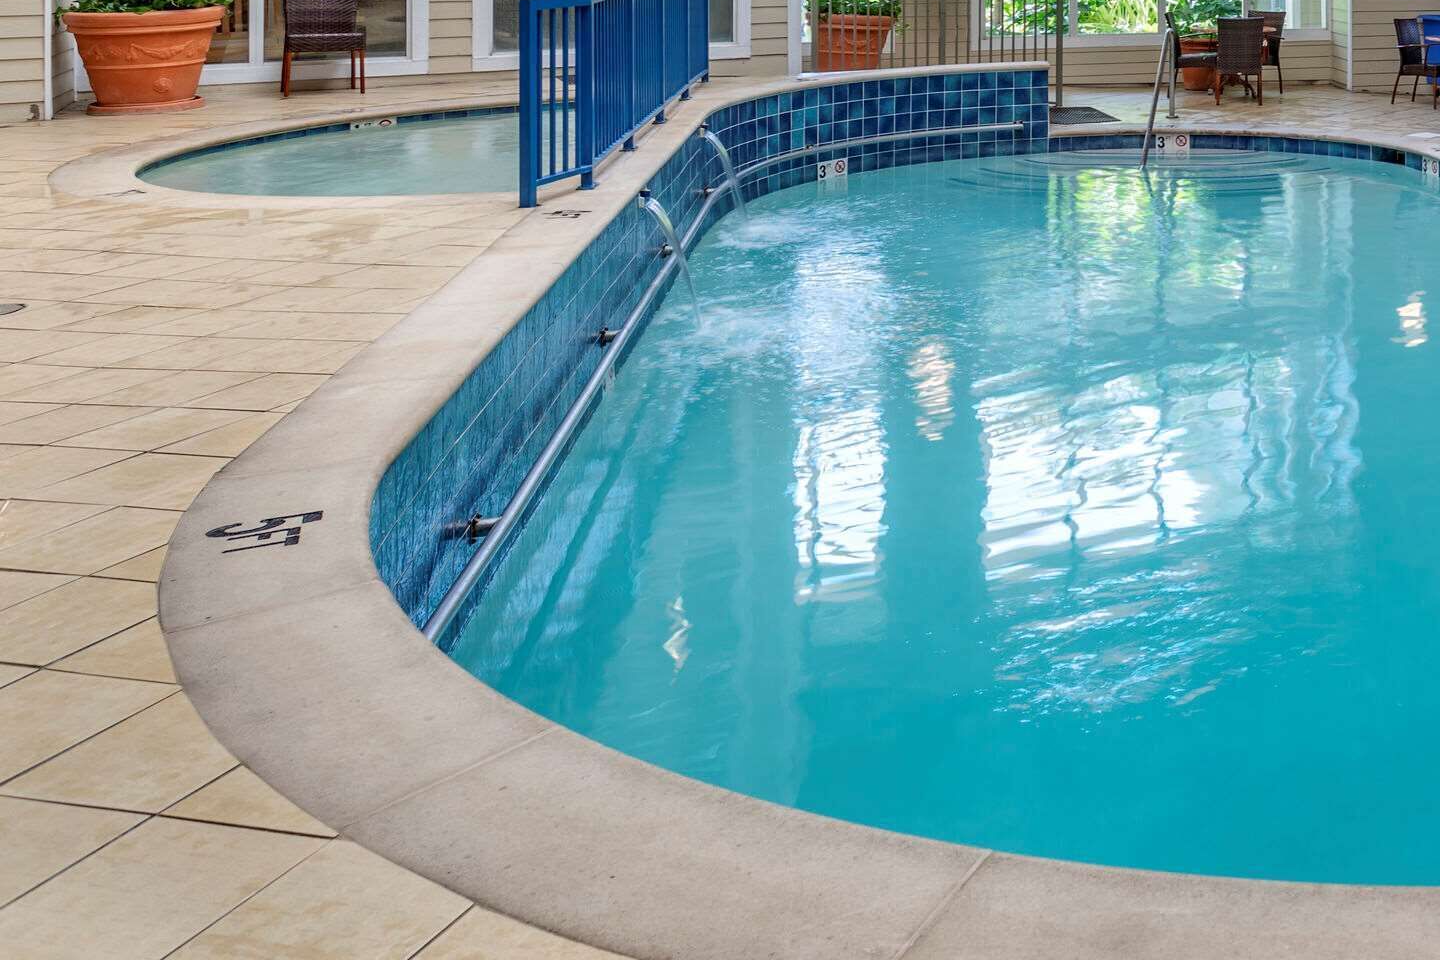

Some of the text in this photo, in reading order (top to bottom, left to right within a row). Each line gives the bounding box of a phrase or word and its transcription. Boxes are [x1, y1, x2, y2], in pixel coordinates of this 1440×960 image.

[1158, 136, 1165, 148] 3
[819, 165, 826, 178] 3
[205, 510, 324, 554] 5 FT
